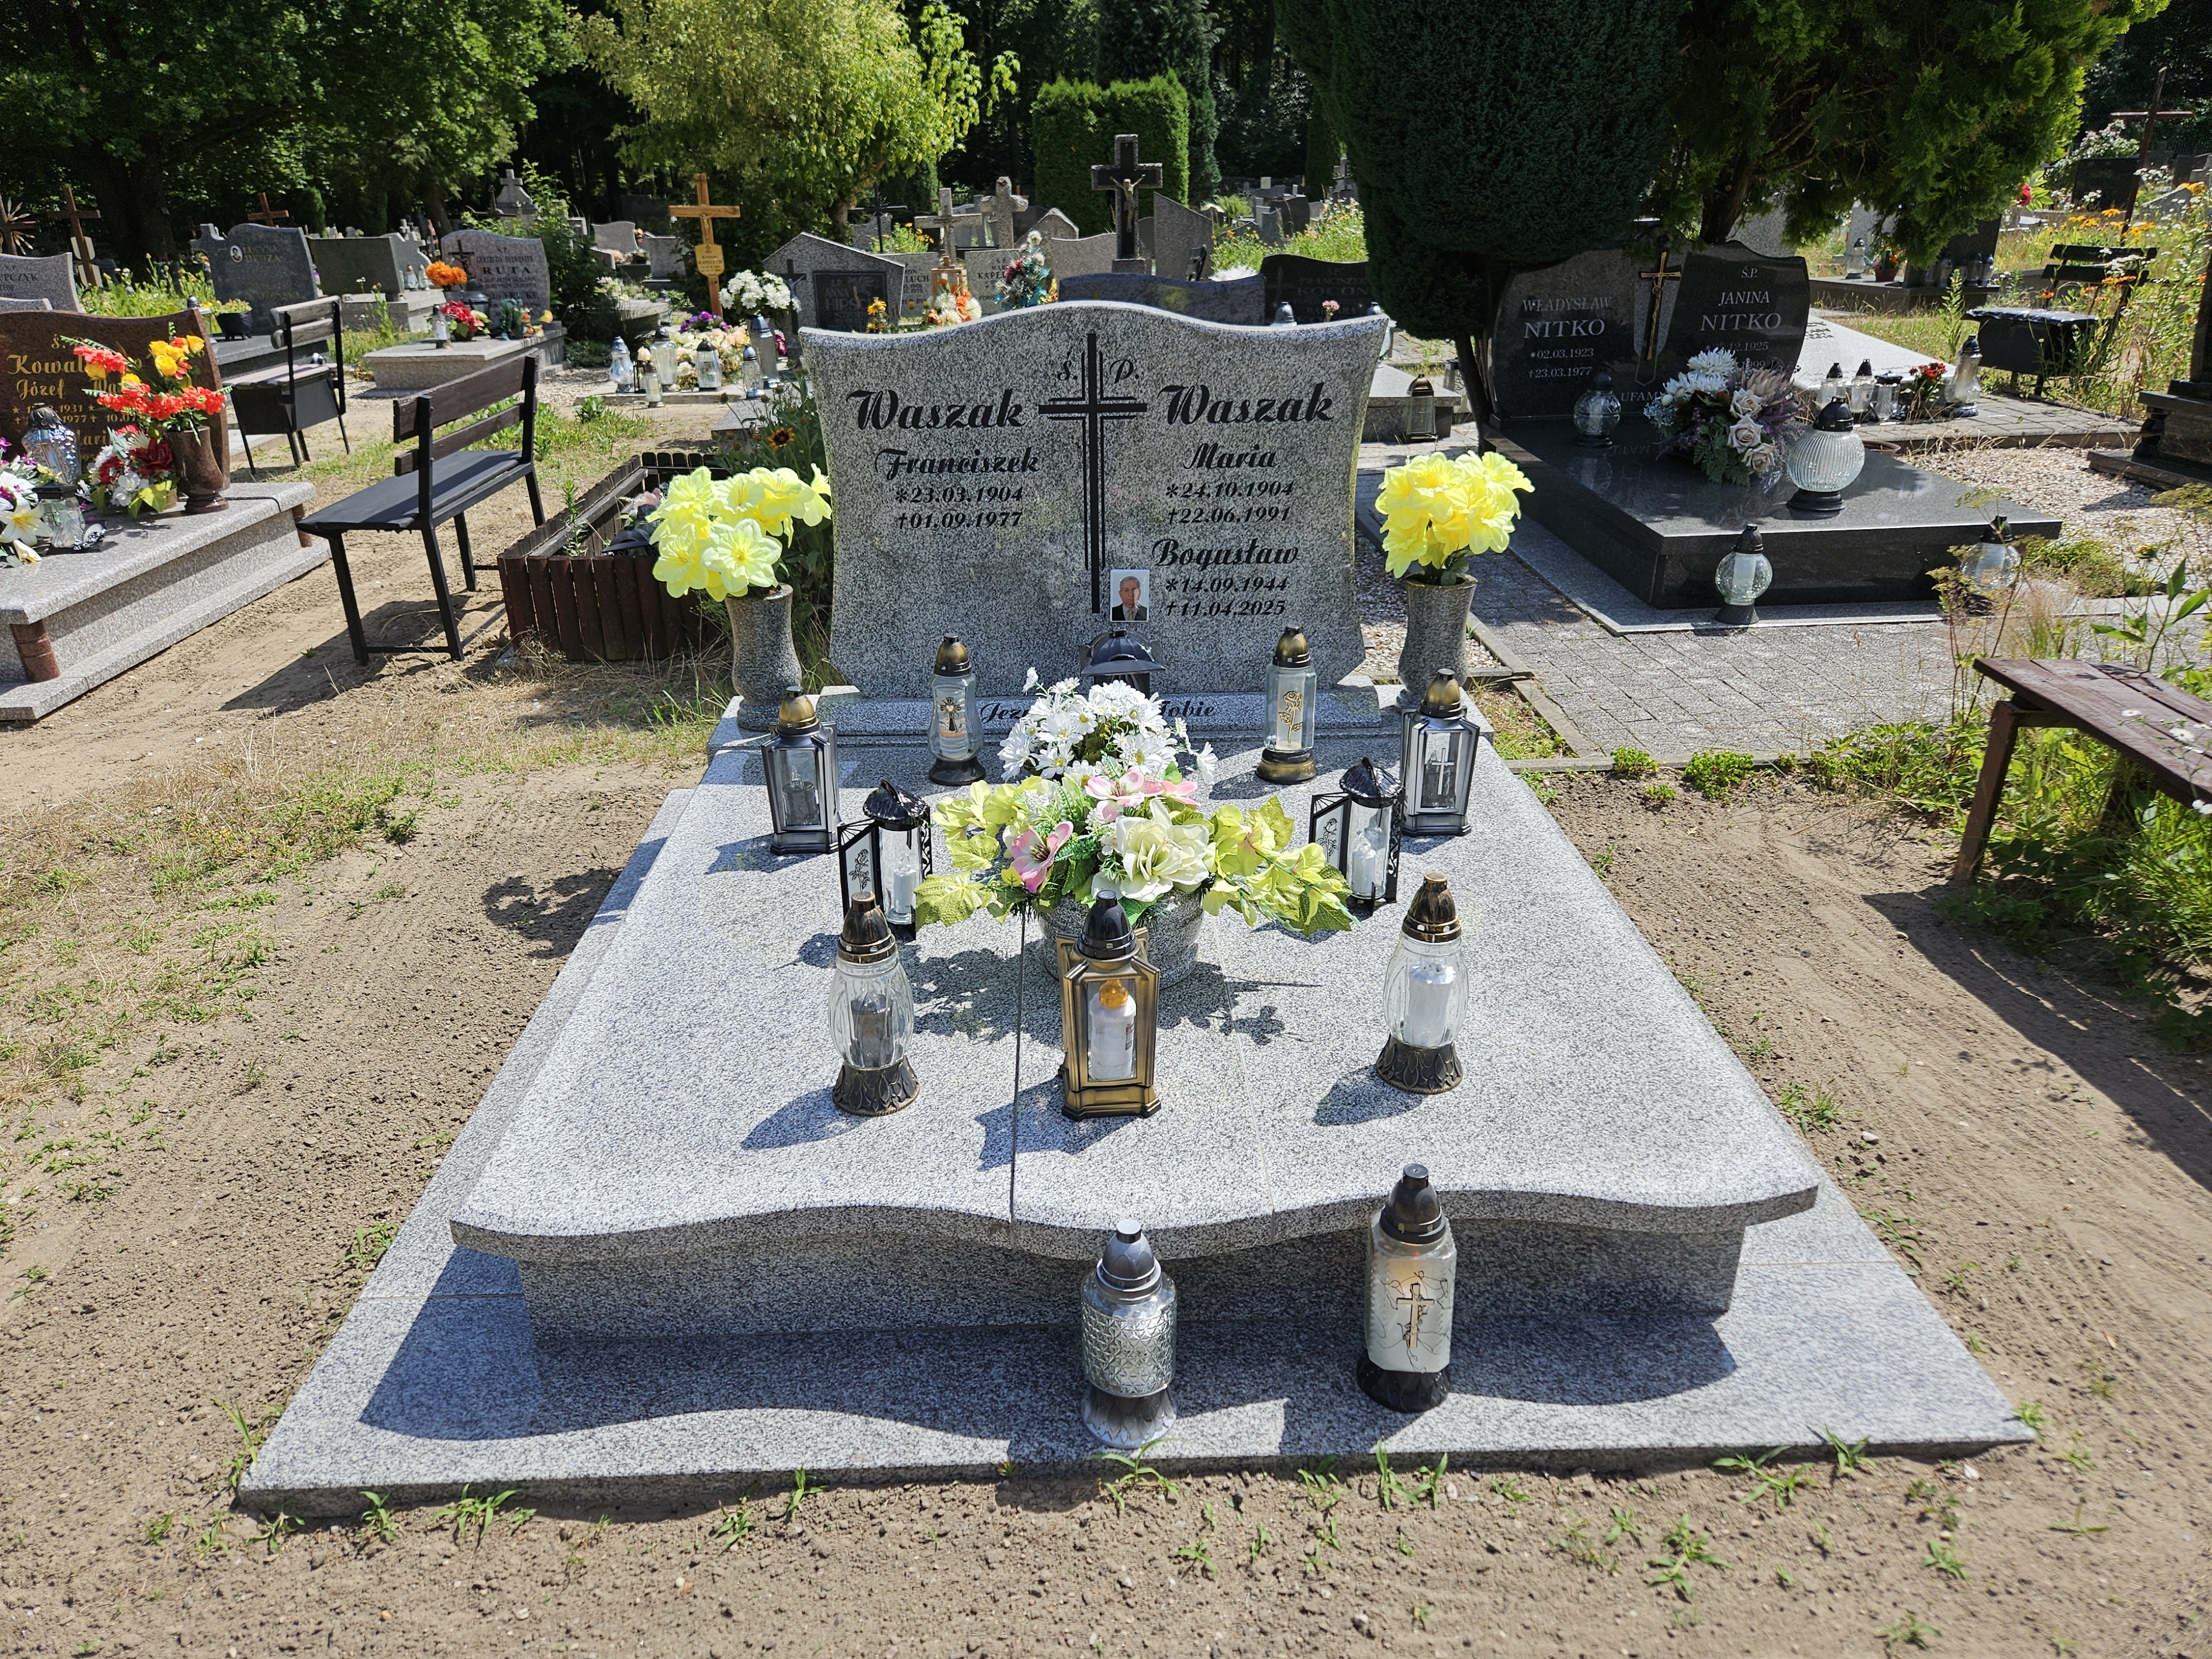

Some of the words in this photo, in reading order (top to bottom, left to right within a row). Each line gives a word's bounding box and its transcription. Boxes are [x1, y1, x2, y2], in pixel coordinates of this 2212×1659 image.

[482, 266, 532, 275] RUTA
[1522, 297, 1611, 312] WŁADYSŁAW
[1718, 291, 1770, 306] JANINA
[1524, 319, 1605, 338] NITKO
[1700, 312, 1782, 331] NITKO
[16, 378, 65, 400] Józef
[846, 388, 1026, 431] Waszak
[1157, 382, 1334, 425] Waszak
[874, 447, 1040, 481] Franciszek
[1182, 442, 1280, 469] Maria
[1152, 538, 1300, 572] Bogusław
